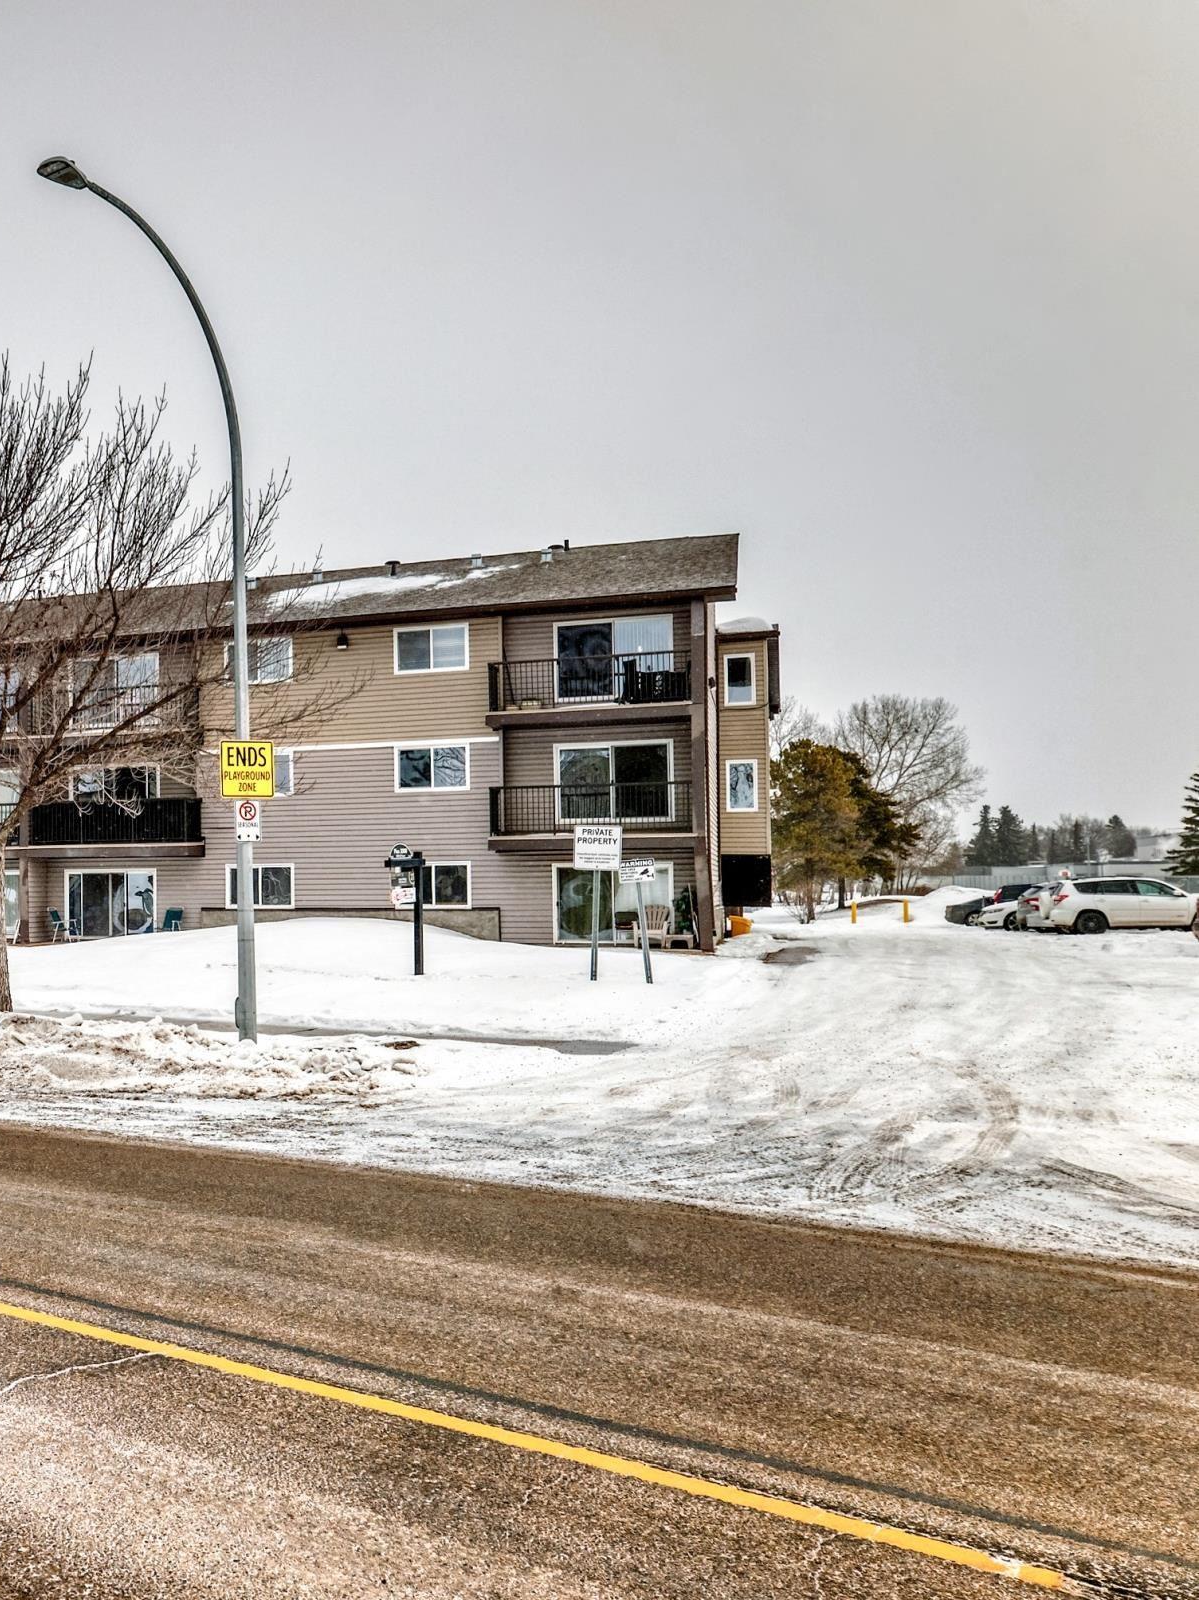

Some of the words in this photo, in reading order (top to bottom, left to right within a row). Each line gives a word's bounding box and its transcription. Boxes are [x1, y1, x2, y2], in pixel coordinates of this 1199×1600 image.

[227, 747, 267, 767] ENDS
[224, 771, 270, 780] PLAYGROUND
[238, 782, 257, 792] ZONE
[582, 828, 613, 836] PRIVATE
[577, 837, 618, 845] PROPERTY
[620, 859, 653, 868] WARNING
